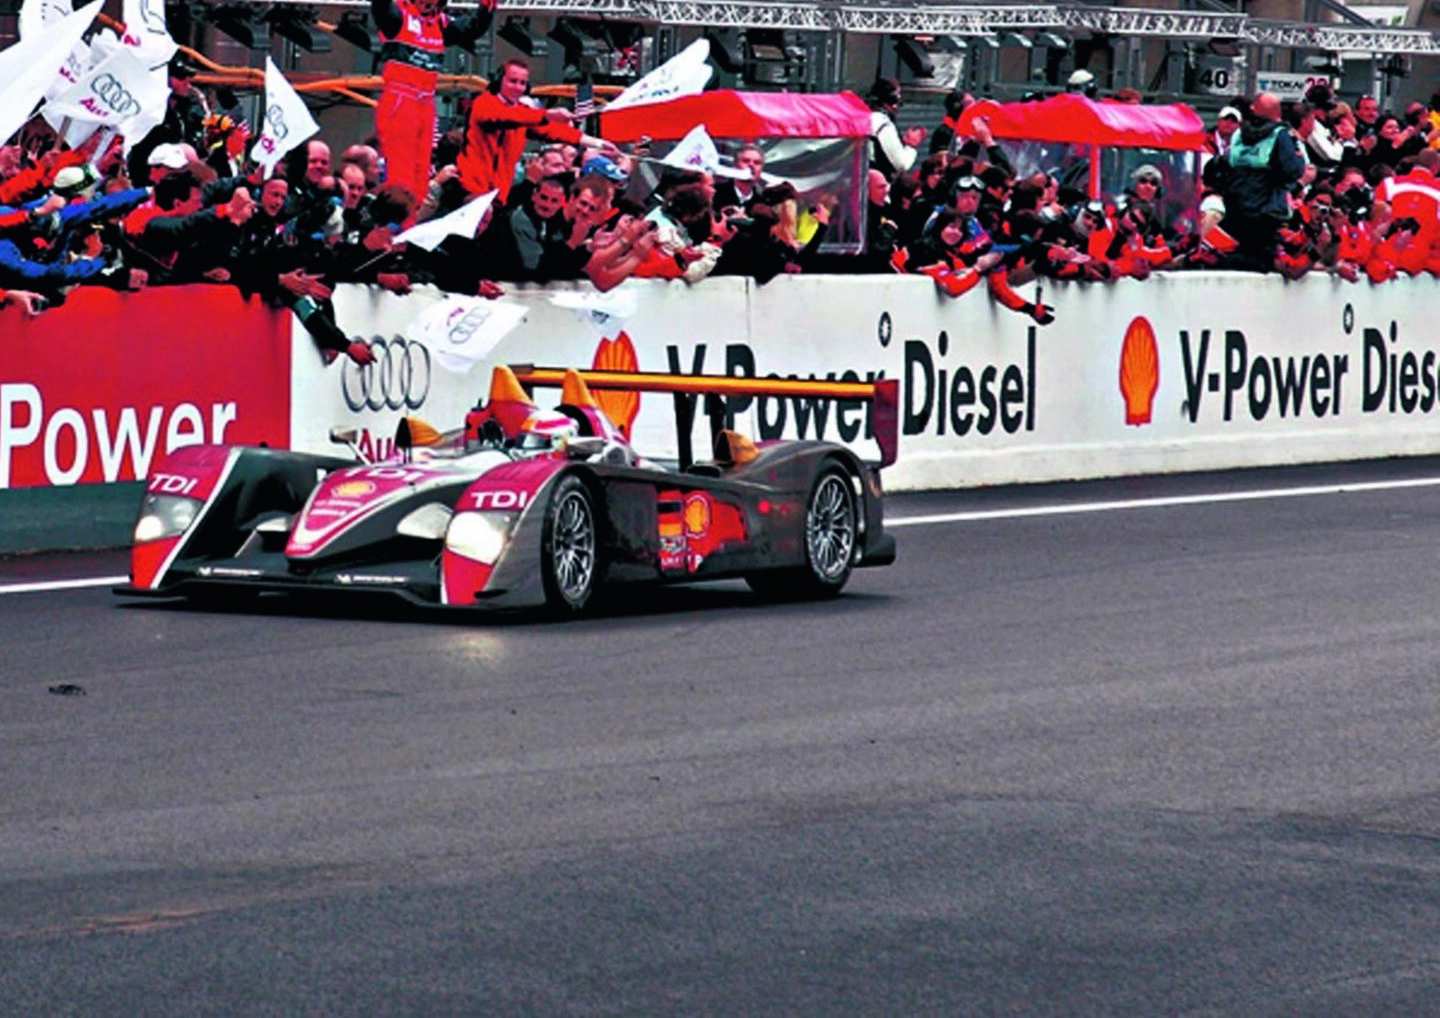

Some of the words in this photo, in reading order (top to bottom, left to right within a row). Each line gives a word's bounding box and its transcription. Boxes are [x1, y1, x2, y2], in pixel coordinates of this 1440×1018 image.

[1199, 69, 1229, 89] 40
[903, 325, 1037, 437] Diesel
[1179, 329, 1348, 423] V-Power
[1362, 319, 1440, 414] Dies
[150, 473, 197, 494] TDI
[471, 490, 527, 508] TDI
